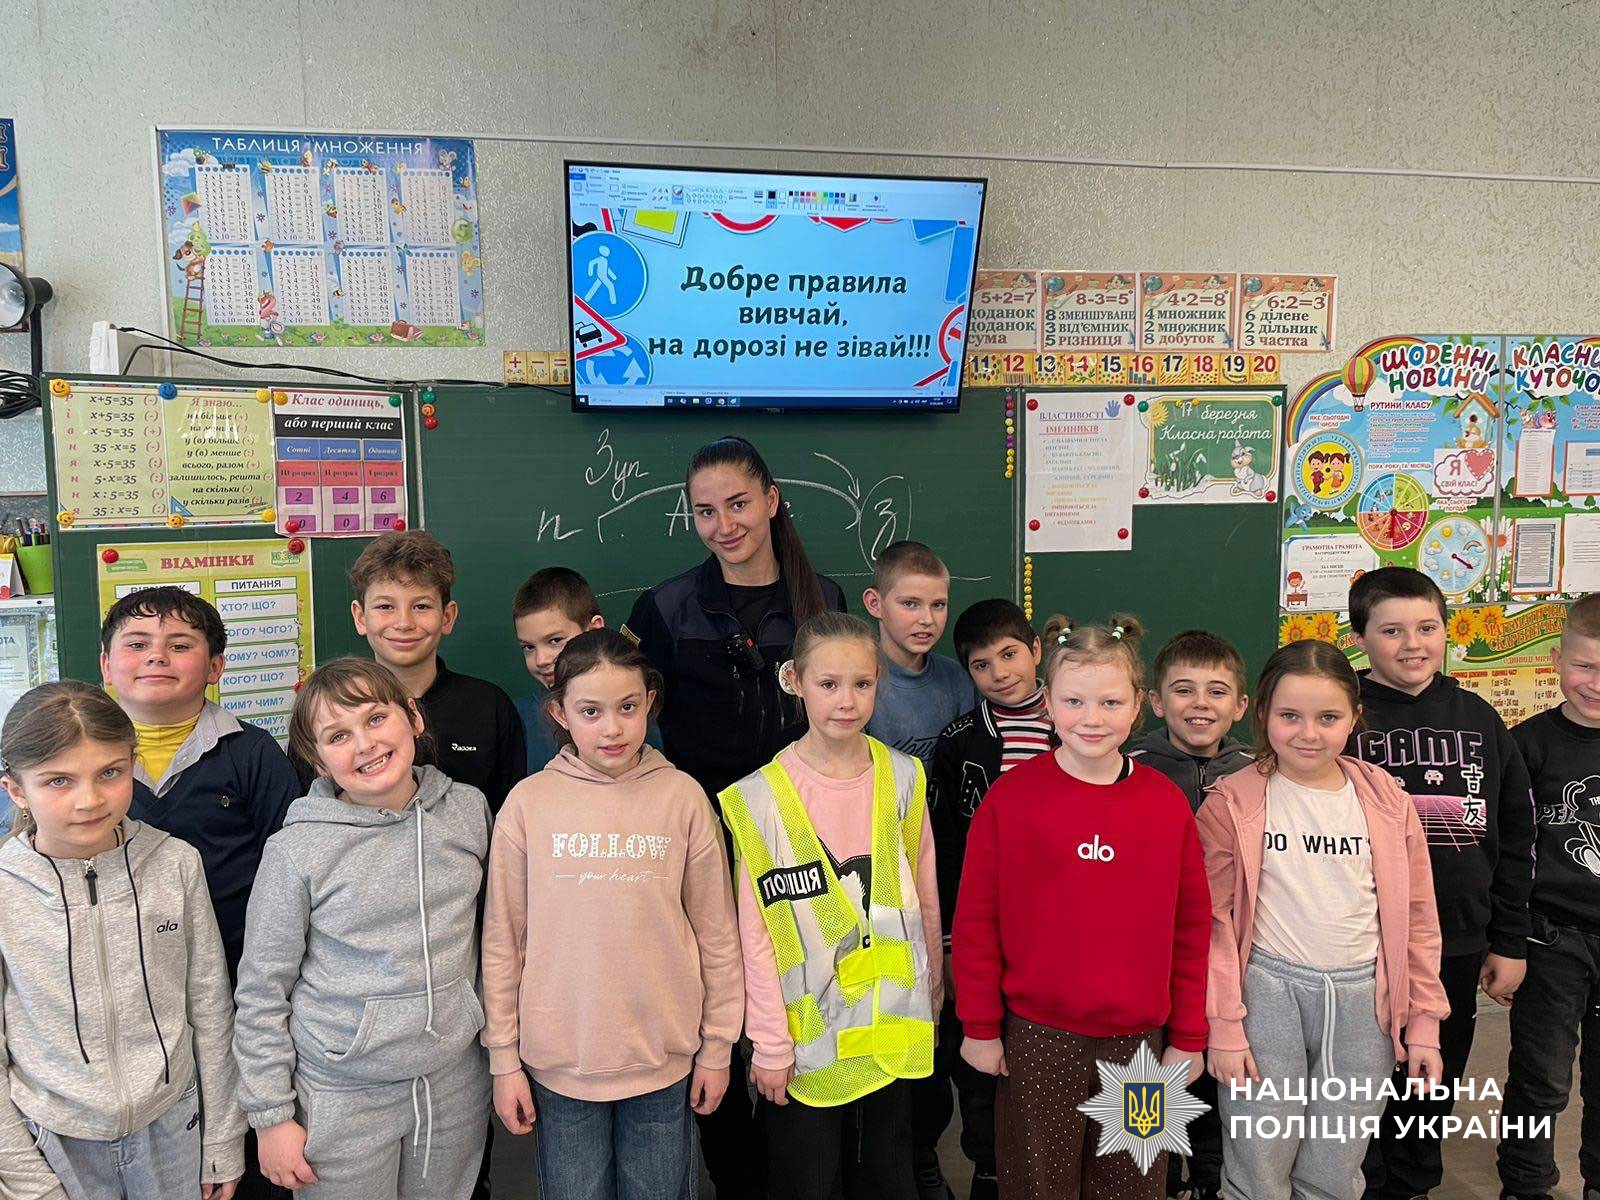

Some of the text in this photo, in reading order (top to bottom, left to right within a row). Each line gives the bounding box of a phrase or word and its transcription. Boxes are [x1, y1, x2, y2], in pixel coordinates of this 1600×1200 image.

[211, 137, 423, 155] ТАБЛИЦЯ МНОЖЕННЯ
[681, 264, 907, 300] Добре правила
[981, 291, 1035, 304] 5+2=7
[1076, 292, 1129, 305] 8-3=5
[1267, 295, 1326, 310] 6:2=3
[739, 301, 848, 328] вивчай,
[1045, 309, 1056, 321] 8
[1145, 308, 1226, 320] 4 множник
[1245, 309, 1309, 322] 6 ділене
[1045, 322, 1056, 333] 3
[1145, 321, 1226, 333] 2 множник
[1245, 321, 1318, 335] 2 дільник
[968, 335, 1007, 348] сума
[1045, 335, 1122, 348] 5 РІЗНИЦЯ
[1144, 333, 1215, 346] 8 добуток
[1245, 335, 1308, 347] 3 частка
[648, 334, 931, 363] на дорозі не зівай!!!
[1003, 355, 1024, 372] 12
[1035, 355, 1056, 372] 13
[1101, 355, 1121, 372] 15
[1132, 355, 1154, 373] 16
[1163, 355, 1184, 373] 17
[1194, 355, 1213, 373] 18
[1224, 355, 1245, 373] 19
[1253, 355, 1276, 373] 20
[1382, 344, 1496, 373] ЩОДЕННІ
[1389, 368, 1488, 393] НОВИНИ
[191, 398, 200, 408] Я
[292, 394, 384, 410] Клас одиниць,
[1370, 401, 1432, 410] РУТИНИ КЛАСУ
[1200, 404, 1257, 424] березня
[284, 416, 394, 431] або перший клас
[1160, 424, 1273, 444] Класна робота
[1449, 459, 1461, 476] Я
[295, 491, 387, 502] 2 4 6
[343, 517, 350, 528] 0
[382, 517, 389, 527] 0
[160, 554, 255, 570] ВІДМІНКИ
[231, 580, 281, 590] ПИТАННЯ
[221, 601, 276, 612] ХТО? ЩО?
[259, 624, 293, 635] ЧОГО?
[261, 648, 297, 660] ЧОМУ?
[223, 672, 285, 686] КОГО? ЩО?
[224, 697, 284, 711] КИМ? ЧИМ?
[1357, 727, 1483, 769] GAME
[551, 833, 672, 860] FOLLOW
[1077, 834, 1115, 862] alo
[1302, 834, 1363, 855] WHAT
